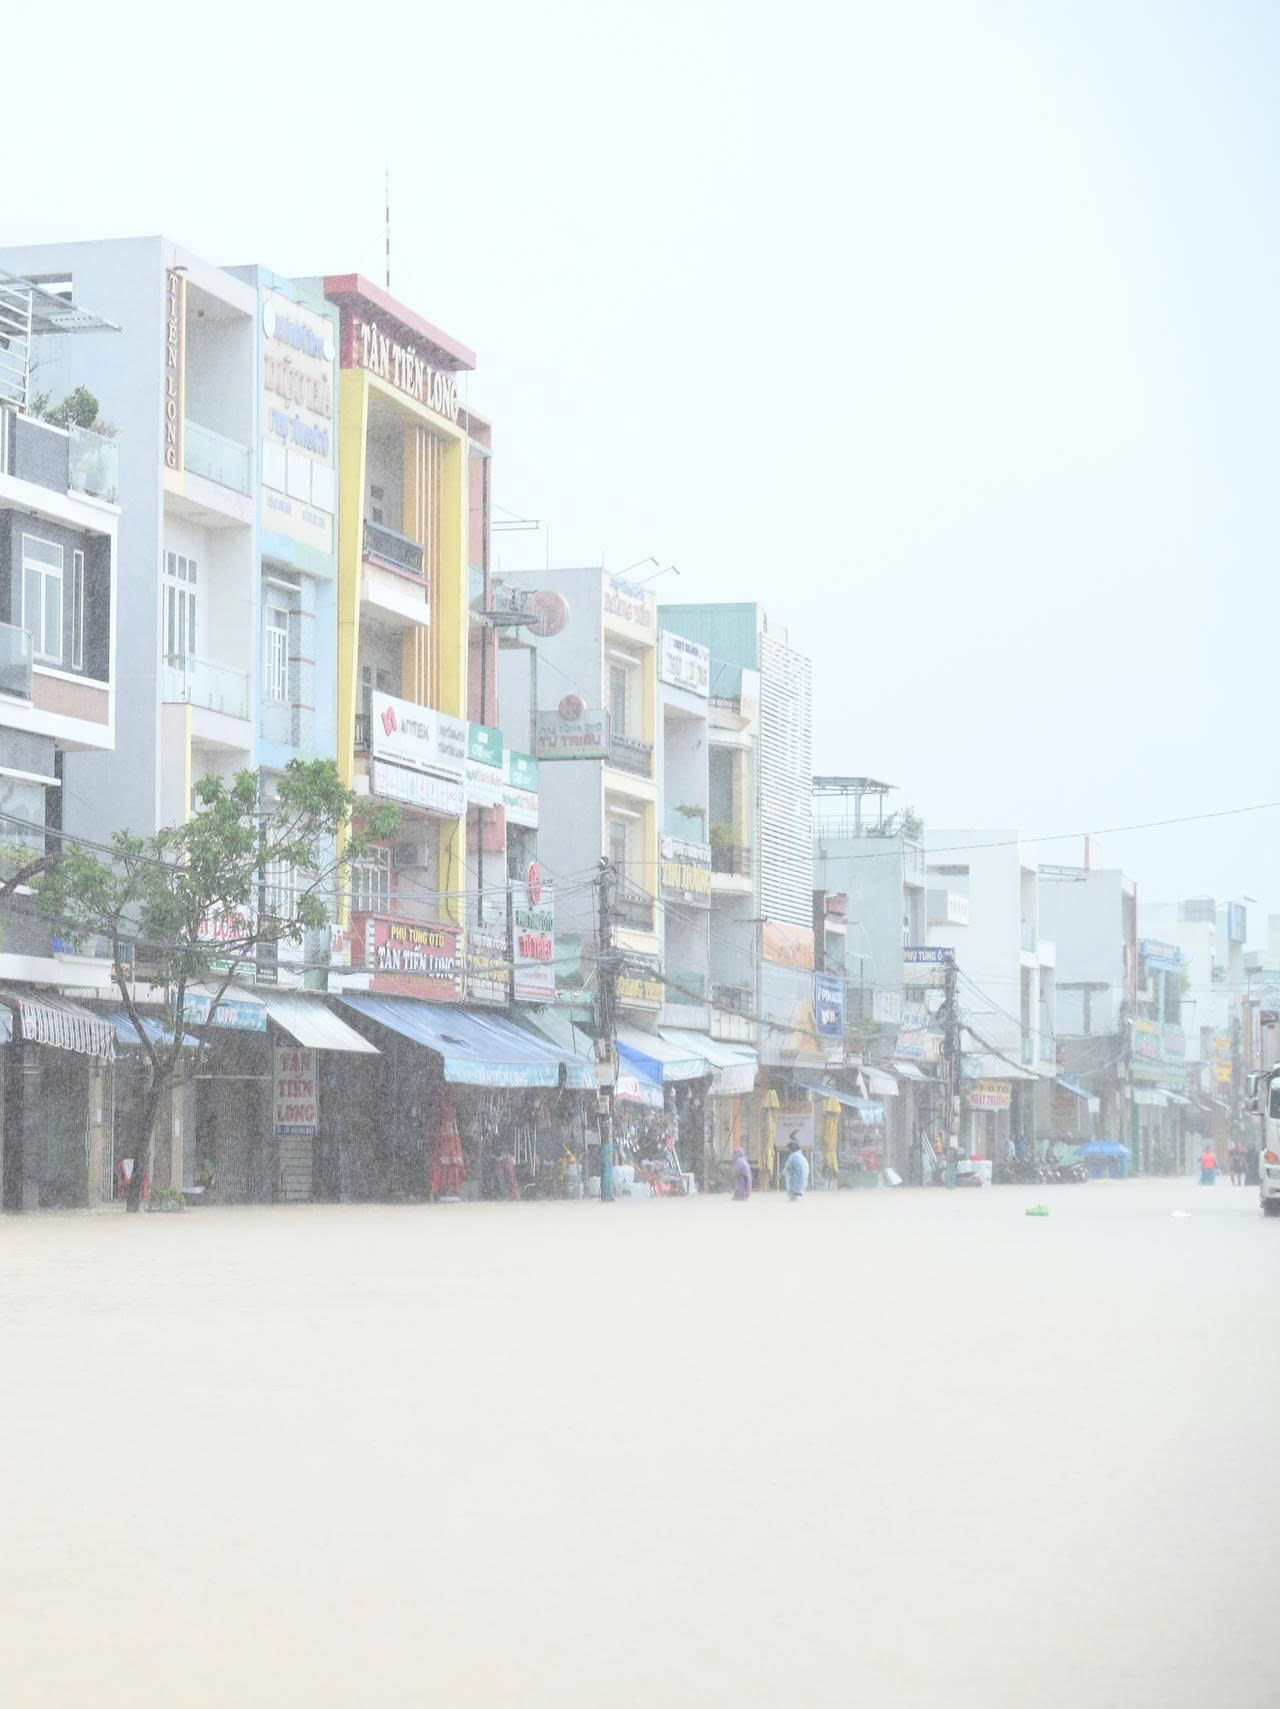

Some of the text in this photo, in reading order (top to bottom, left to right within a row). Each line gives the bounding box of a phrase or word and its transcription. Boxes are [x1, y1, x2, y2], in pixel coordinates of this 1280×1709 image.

[427, 366, 461, 424] LONG
[378, 941, 401, 970] TÂN
[403, 944, 426, 971] TIẾN
[277, 1103, 315, 1122] LONG
